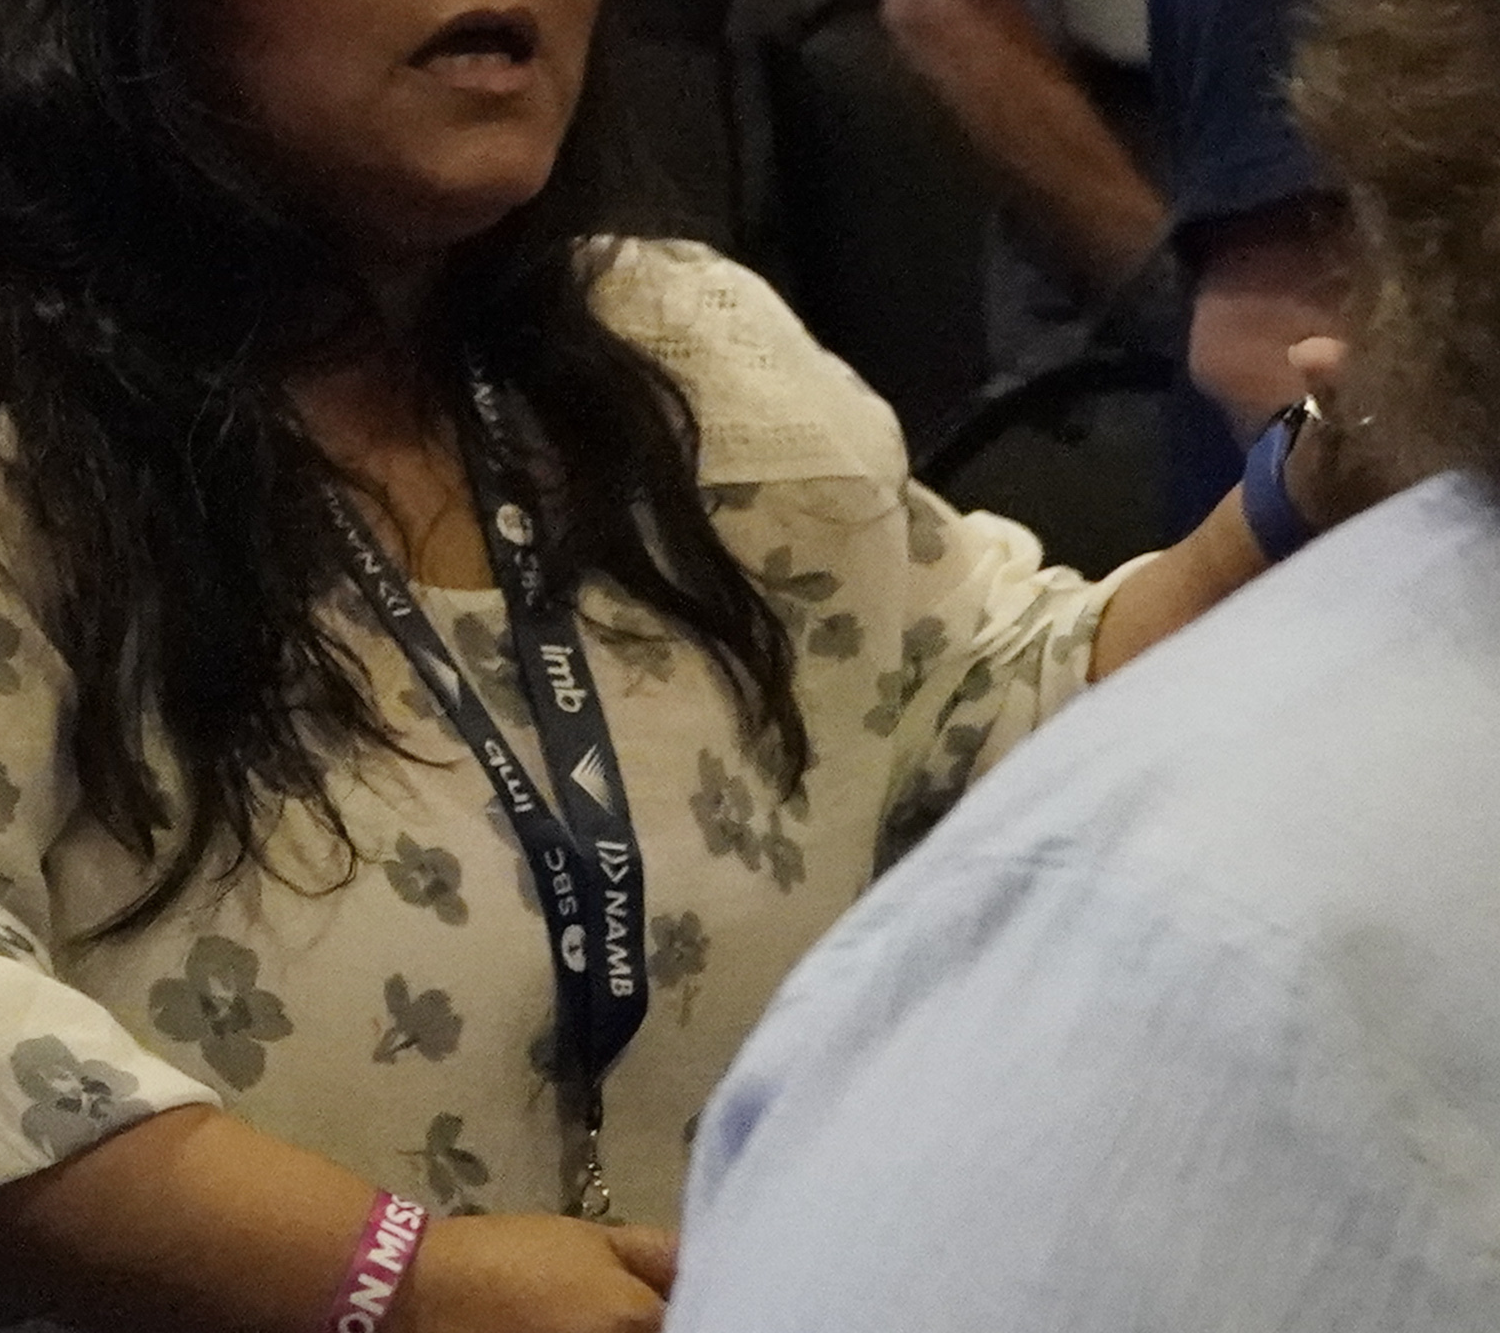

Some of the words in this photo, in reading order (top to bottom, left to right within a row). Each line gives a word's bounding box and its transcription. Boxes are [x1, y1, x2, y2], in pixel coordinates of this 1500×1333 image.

[483, 739, 532, 814] imb
[540, 644, 586, 715] imb
[602, 888, 635, 999] NAMB
[544, 845, 579, 914] SBC
